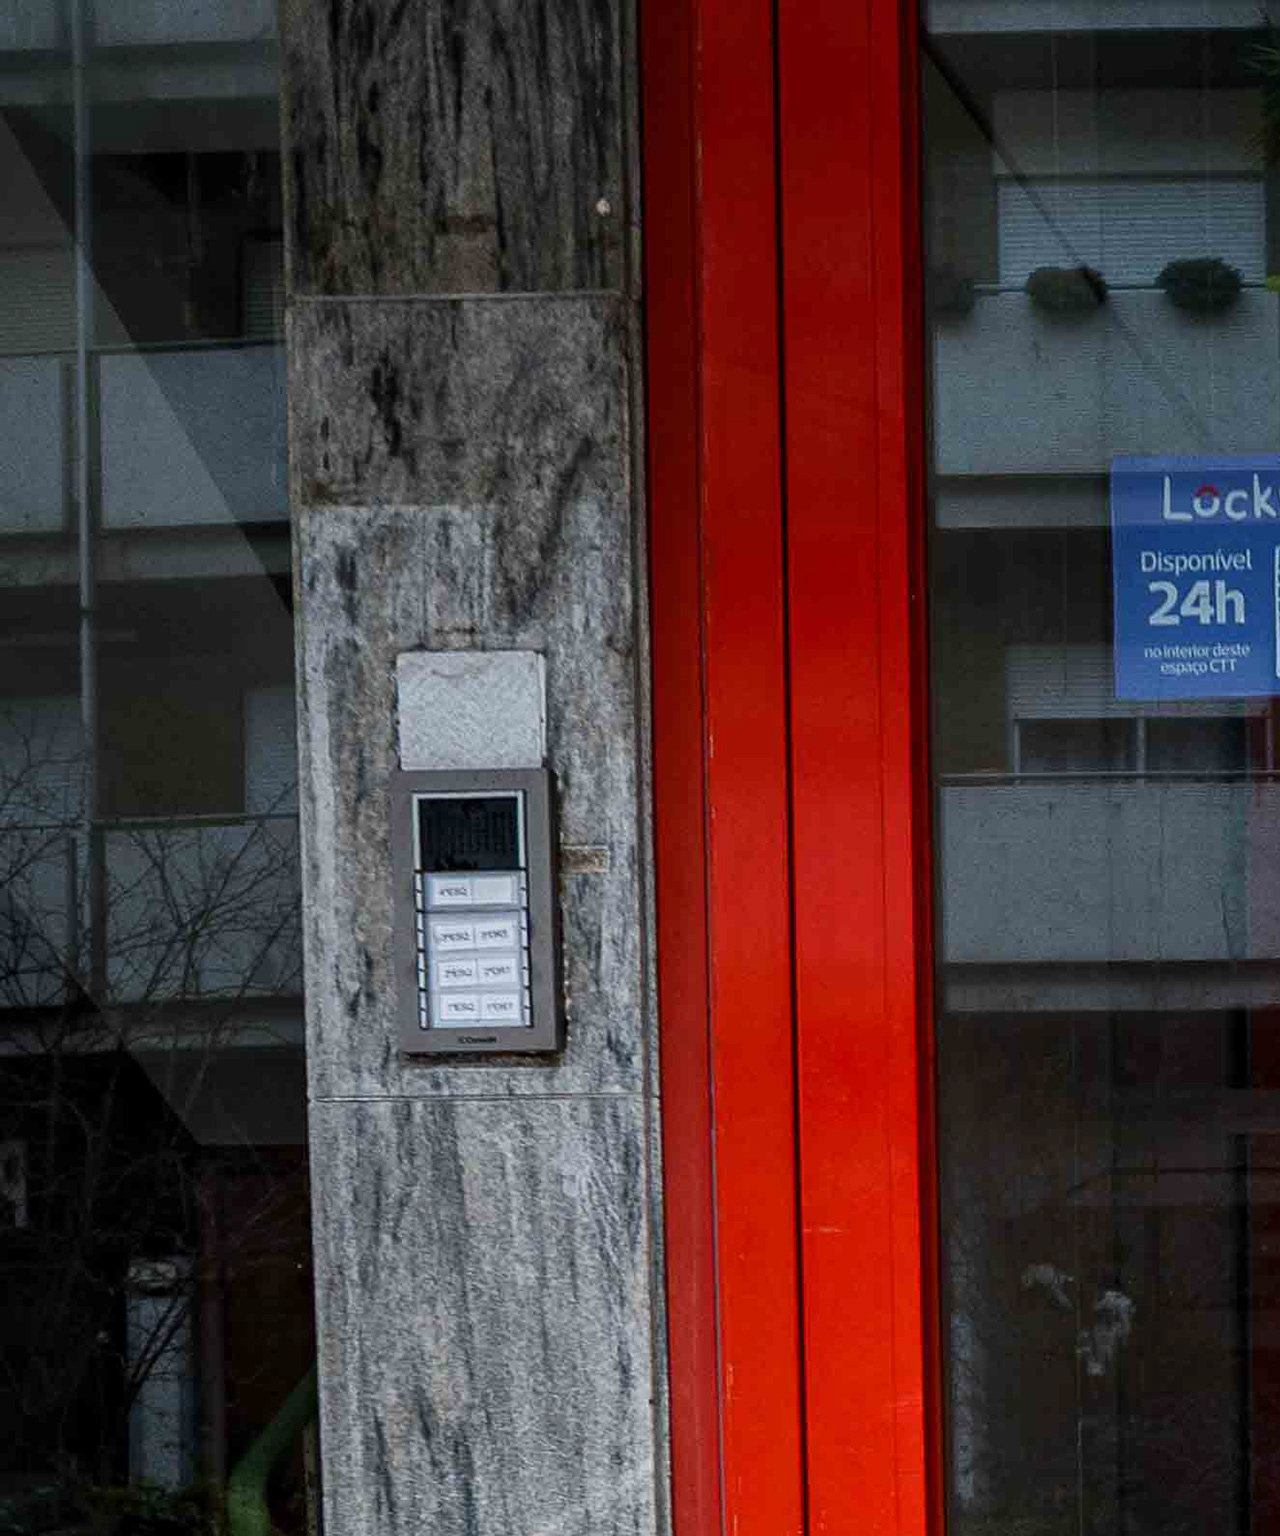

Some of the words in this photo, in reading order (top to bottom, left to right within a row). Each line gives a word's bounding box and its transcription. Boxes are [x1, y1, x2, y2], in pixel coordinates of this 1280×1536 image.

[1141, 549, 1252, 576] Disponível
[1149, 580, 1245, 625] 24h
[1144, 648, 1156, 658] no
[1162, 644, 1208, 657] interior
[1213, 643, 1250, 657] deste
[1160, 662, 1207, 676] espaço
[1210, 660, 1237, 673] CTT
